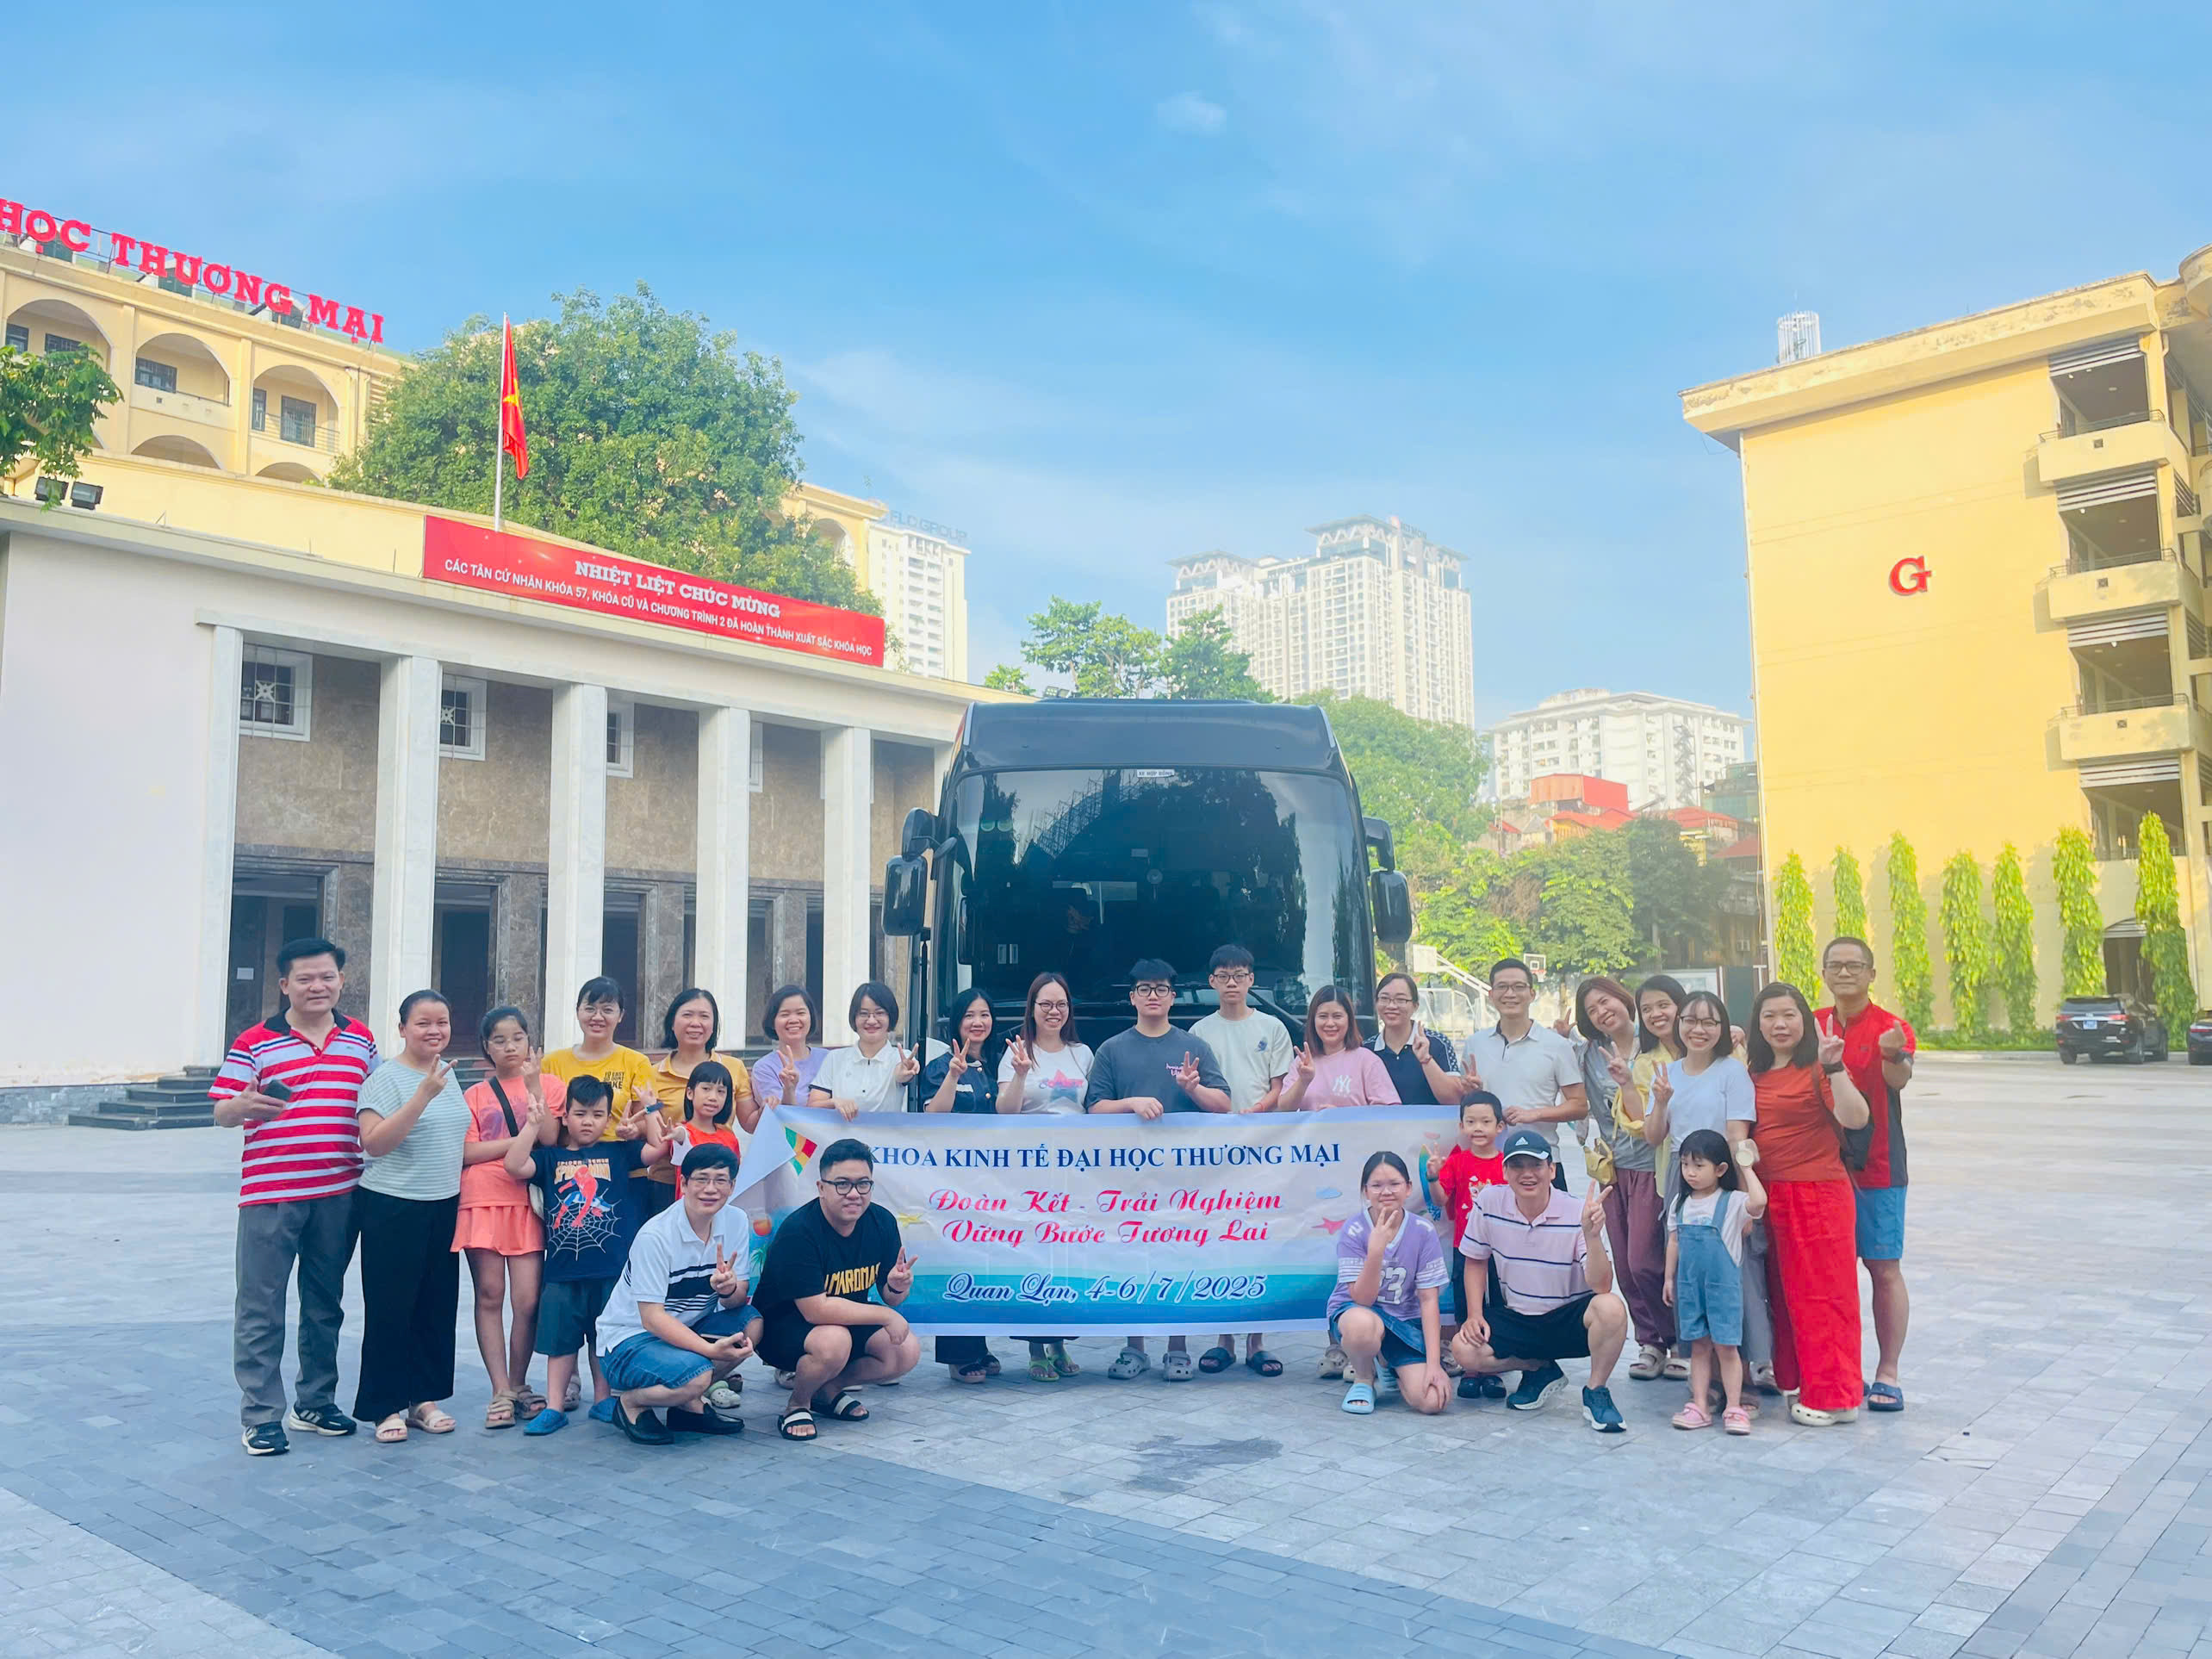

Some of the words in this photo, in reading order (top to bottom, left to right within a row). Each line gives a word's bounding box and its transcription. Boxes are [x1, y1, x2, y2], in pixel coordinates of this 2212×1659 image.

[0, 198, 90, 254] HỌC
[308, 293, 384, 344] MẠI
[575, 561, 632, 586] NHIỆT
[636, 575, 676, 596] LIỆT
[679, 584, 729, 606] CHÚC
[731, 595, 780, 618] MỪNG
[1889, 556, 1931, 595] G
[444, 558, 469, 574] CÁC
[470, 563, 493, 580] TÂN
[513, 573, 543, 590] NHÂN
[545, 581, 574, 596] KHÓA
[575, 587, 589, 602] 57,
[593, 590, 619, 606] KHÓA
[621, 594, 635, 608] CŨ
[637, 597, 649, 612] VÀ
[651, 602, 690, 619] CHƯƠNG
[691, 610, 718, 626] TRÌNH
[720, 616, 725, 627] 2
[727, 617, 739, 631] ĐÃ
[741, 621, 765, 636] HOÀN
[766, 626, 794, 642] THÀNH
[796, 631, 817, 646] XUẤT
[817, 635, 833, 649] SẮC
[834, 641, 855, 654] KHÓA
[856, 644, 873, 657] HỌC
[869, 1146, 937, 1166] KHOA
[945, 1148, 1010, 1167] KINH
[1017, 1144, 1049, 1167] TẾ
[1057, 1148, 1101, 1172] ĐẠI
[1109, 1147, 1165, 1171] HỌC
[1171, 1144, 1283, 1166] THƯƠNG
[1290, 1143, 1341, 1167] MẠI
[929, 1189, 1008, 1212] Đoàn
[1018, 1190, 1071, 1213] Kết
[1097, 1190, 1159, 1213] Trải
[1169, 1189, 1283, 1215] Nghiệm
[942, 1220, 1025, 1248] Vững
[1035, 1221, 1106, 1244] Bước
[1117, 1221, 1210, 1247] Tương
[1218, 1219, 1270, 1242] Lai
[944, 1272, 1013, 1302] Quan
[1017, 1272, 1078, 1304] Lạn,
[1087, 1270, 1267, 1303] 4-6/7/2025
